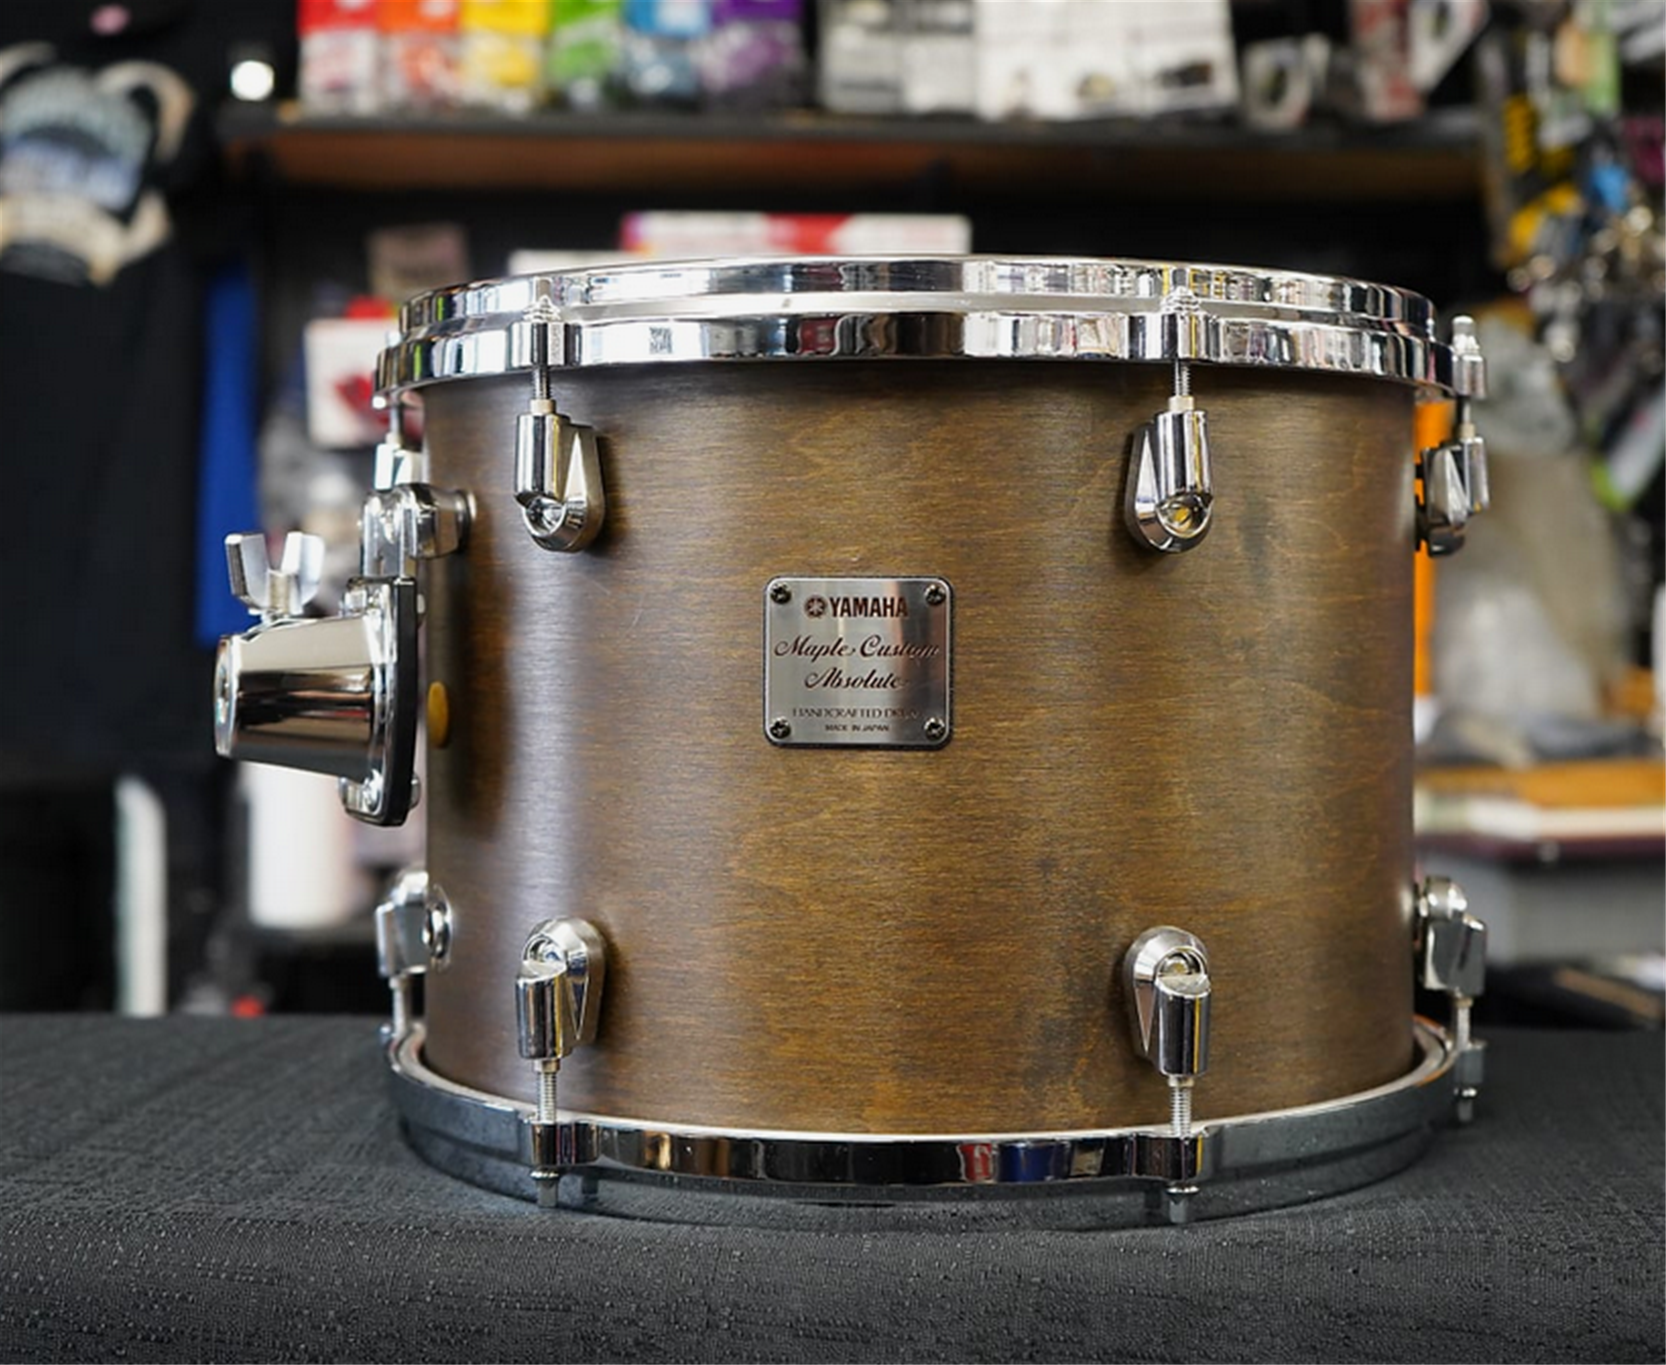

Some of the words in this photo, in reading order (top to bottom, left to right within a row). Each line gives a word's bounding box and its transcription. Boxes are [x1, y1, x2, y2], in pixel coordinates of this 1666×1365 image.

[830, 597, 908, 617] YAMAHA
[774, 635, 856, 663] Maple
[860, 634, 939, 658] Custom
[804, 667, 908, 689] Absolute
[792, 708, 883, 718] HANDCRAFTED
[825, 724, 847, 732] MADE
[852, 724, 860, 732] IN
[862, 724, 889, 732] JAPAN
